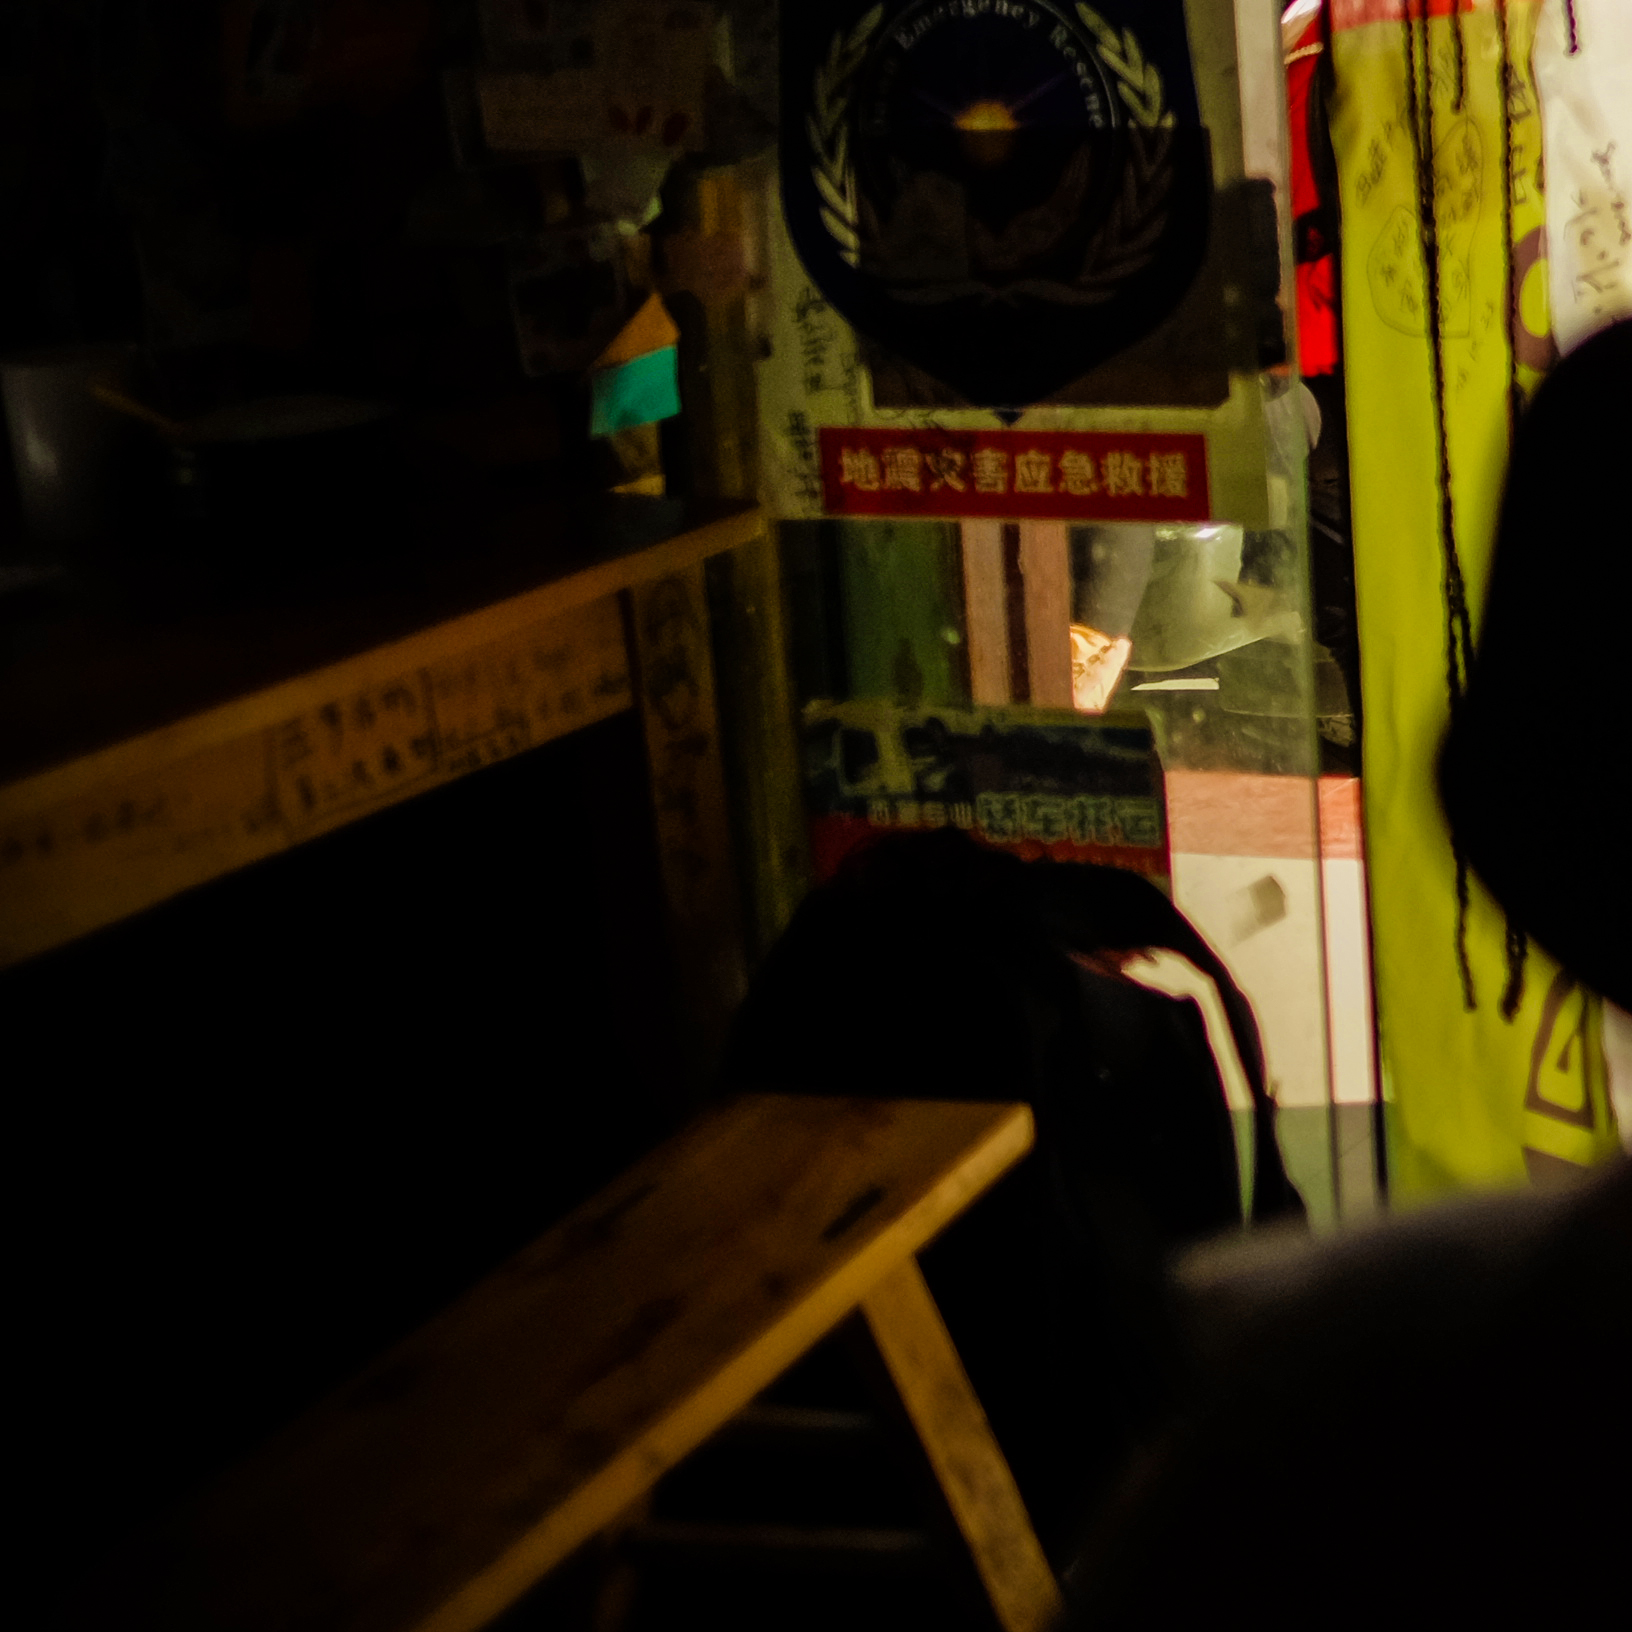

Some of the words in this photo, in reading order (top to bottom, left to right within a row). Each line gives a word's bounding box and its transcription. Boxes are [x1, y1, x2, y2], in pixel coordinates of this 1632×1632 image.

[837, 445, 1190, 499] 地震灾害应急救援
